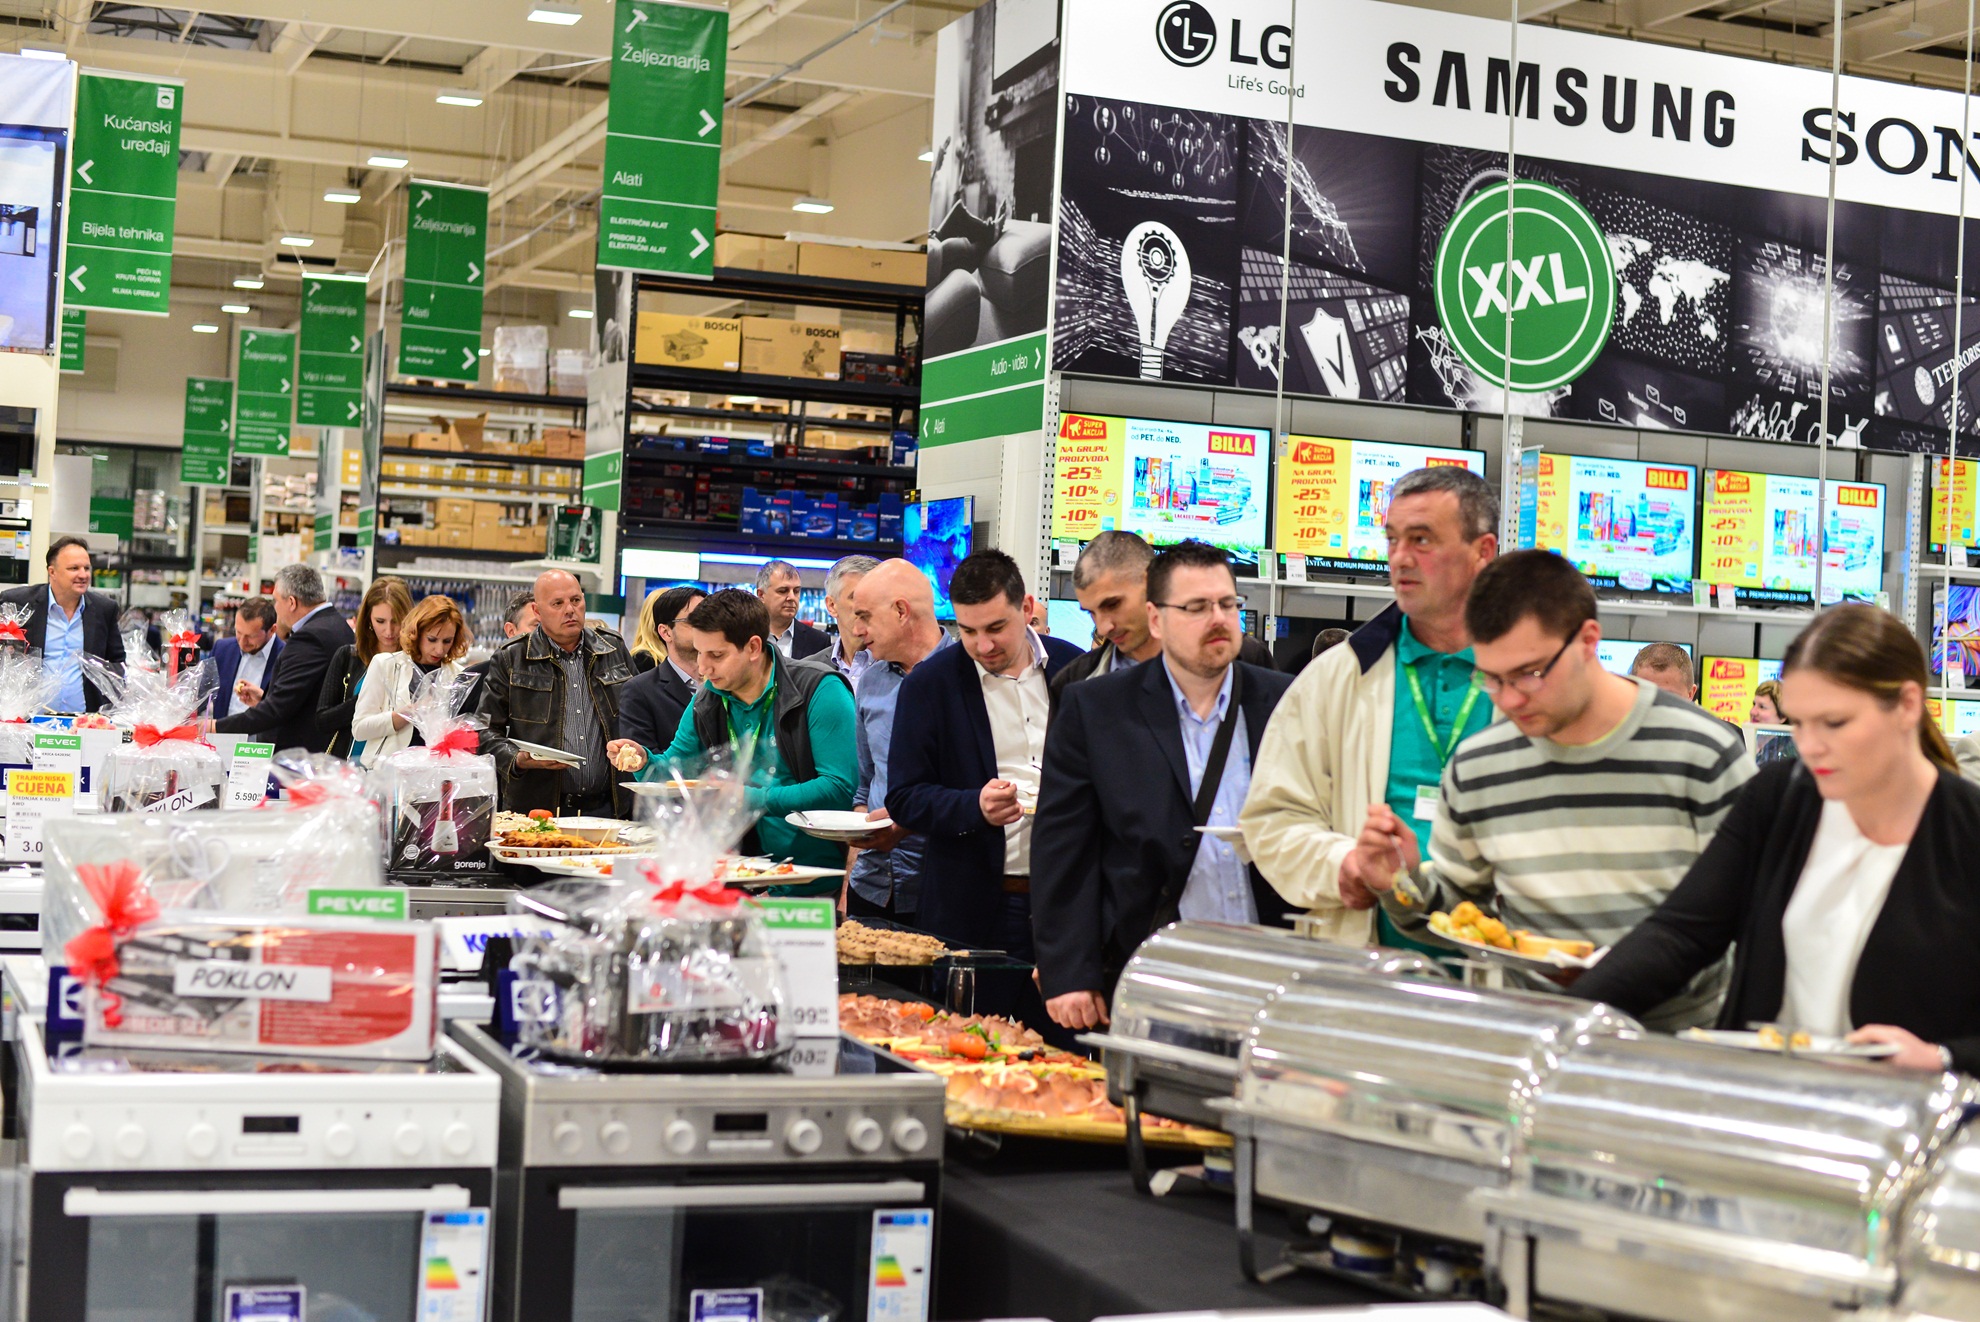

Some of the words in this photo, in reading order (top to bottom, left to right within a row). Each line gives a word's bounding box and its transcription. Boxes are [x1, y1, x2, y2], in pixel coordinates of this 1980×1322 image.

[1230, 18, 1291, 69] LG
[620, 42, 711, 74] Željeznarija
[1228, 74, 1263, 92] Life's
[1384, 41, 1735, 148] SAMSUNG
[104, 114, 172, 135] Kućanski
[121, 139, 170, 158] uređaji
[612, 171, 643, 187] Alati
[413, 214, 476, 237] Željeznarija
[651, 221, 669, 229] ALAT
[82, 221, 115, 238] Bijela
[118, 226, 164, 243] tehnika
[637, 235, 647, 243] ZA
[649, 245, 667, 254] ALAT
[1465, 252, 1587, 318] XXL
[408, 305, 430, 319] Alati
[704, 321, 738, 332] BOSCH
[805, 327, 840, 338] BOSCH
[991, 357, 1008, 376] Audio
[1012, 354, 1028, 371] video
[933, 418, 945, 434] Alati
[1083, 420, 1103, 428] SUPER
[1083, 428, 1104, 437] AKCIJA
[1165, 436, 1181, 444] NED.
[1211, 435, 1254, 455] BILLA
[1313, 446, 1331, 454] SUPER
[1059, 455, 1109, 463] PROIZVODA
[1060, 466, 1102, 480] -25%
[1648, 471, 1687, 489] BILLA
[1061, 485, 1099, 497] -10%
[1293, 488, 1330, 501] -25%
[1839, 488, 1876, 507] BILLA
[1060, 509, 1098, 521] -10%
[1293, 505, 1327, 516] -10%
[1293, 527, 1327, 538] -10%
[1711, 535, 1743, 546] -10%
[1333, 560, 1357, 570] PREMIUM
[1357, 563, 1376, 571] PRIBOR
[1711, 557, 1743, 568] -10%
[39, 738, 77, 746] PEVEC
[238, 746, 270, 755] PEVEC
[15, 782, 66, 794] CIJENA
[234, 791, 258, 802] 5.590
[454, 860, 486, 869] gorenje
[316, 895, 397, 913] PEVEC
[190, 967, 297, 991] POKLON
